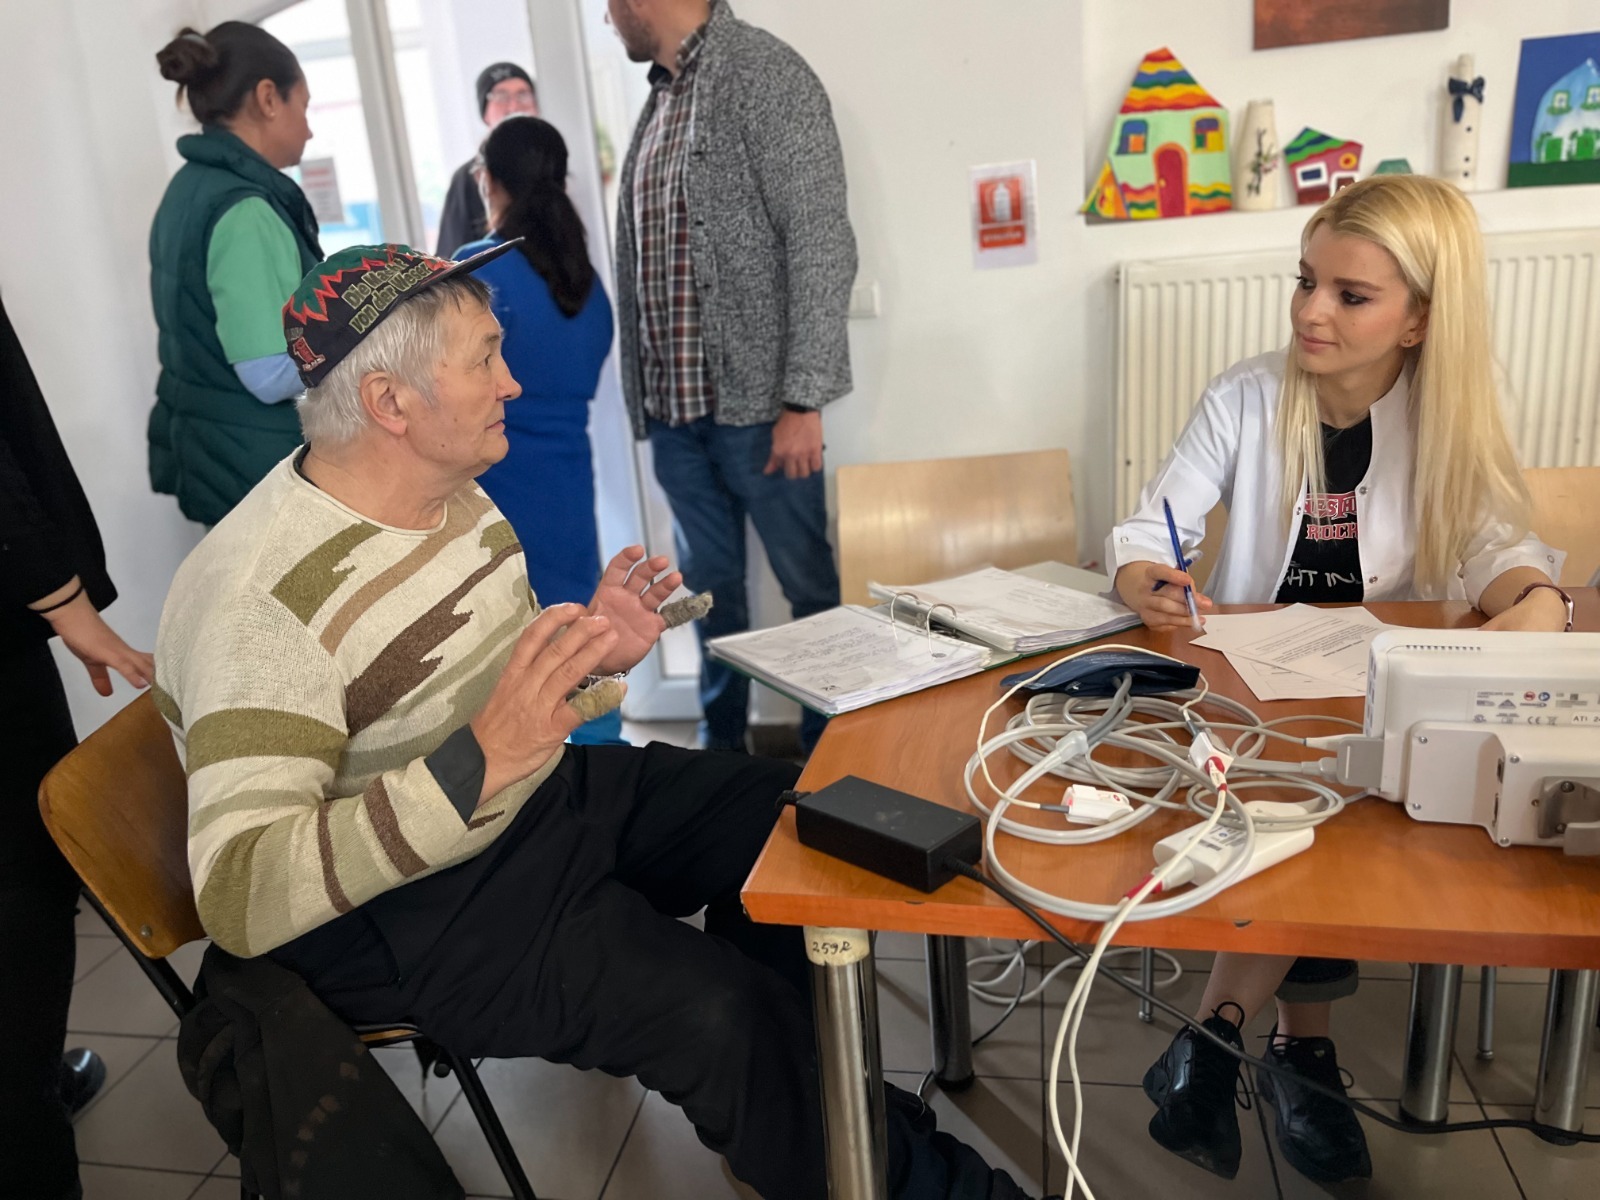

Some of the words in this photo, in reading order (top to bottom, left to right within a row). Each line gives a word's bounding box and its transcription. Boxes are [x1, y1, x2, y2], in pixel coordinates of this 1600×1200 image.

[341, 283, 371, 310] Die
[361, 258, 409, 289] Macht
[349, 304, 380, 335] von
[371, 285, 399, 311] der
[388, 262, 433, 292] Weser
[1283, 568, 1318, 587] HT
